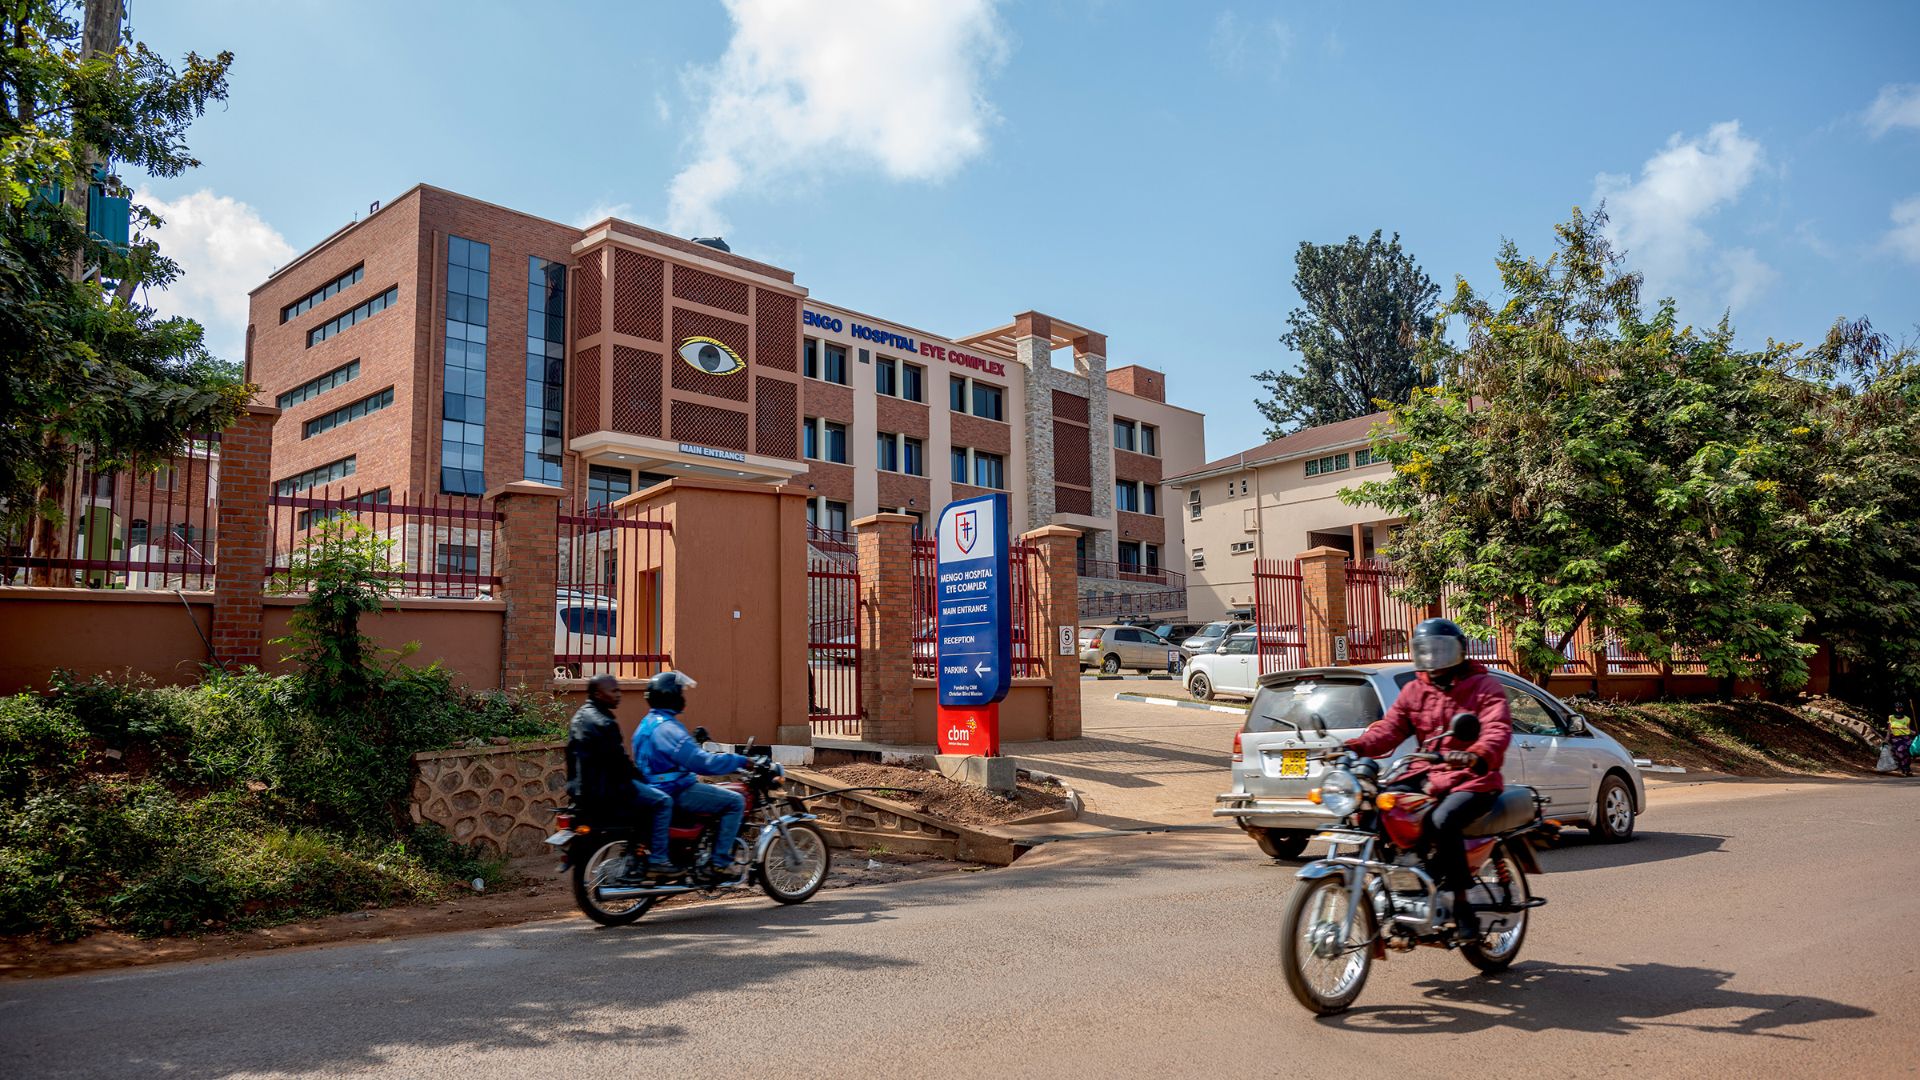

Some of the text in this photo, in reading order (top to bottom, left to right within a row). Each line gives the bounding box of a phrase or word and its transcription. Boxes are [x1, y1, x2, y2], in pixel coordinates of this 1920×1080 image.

[803, 310, 1006, 377] ENGO HOSPITAL EYE COMPLEX
[681, 443, 745, 461] MAIN ENTRANCE
[940, 568, 993, 583] MENGO HOSPITAL
[946, 581, 987, 594] EYE COMPLEX
[942, 604, 988, 616] MAIN ENTRANCE
[943, 636, 975, 645] RECEPTION
[1064, 630, 1070, 641] 5
[1338, 639, 1344, 649] 5
[944, 666, 968, 674] PARKING
[948, 725, 970, 741] cbm
